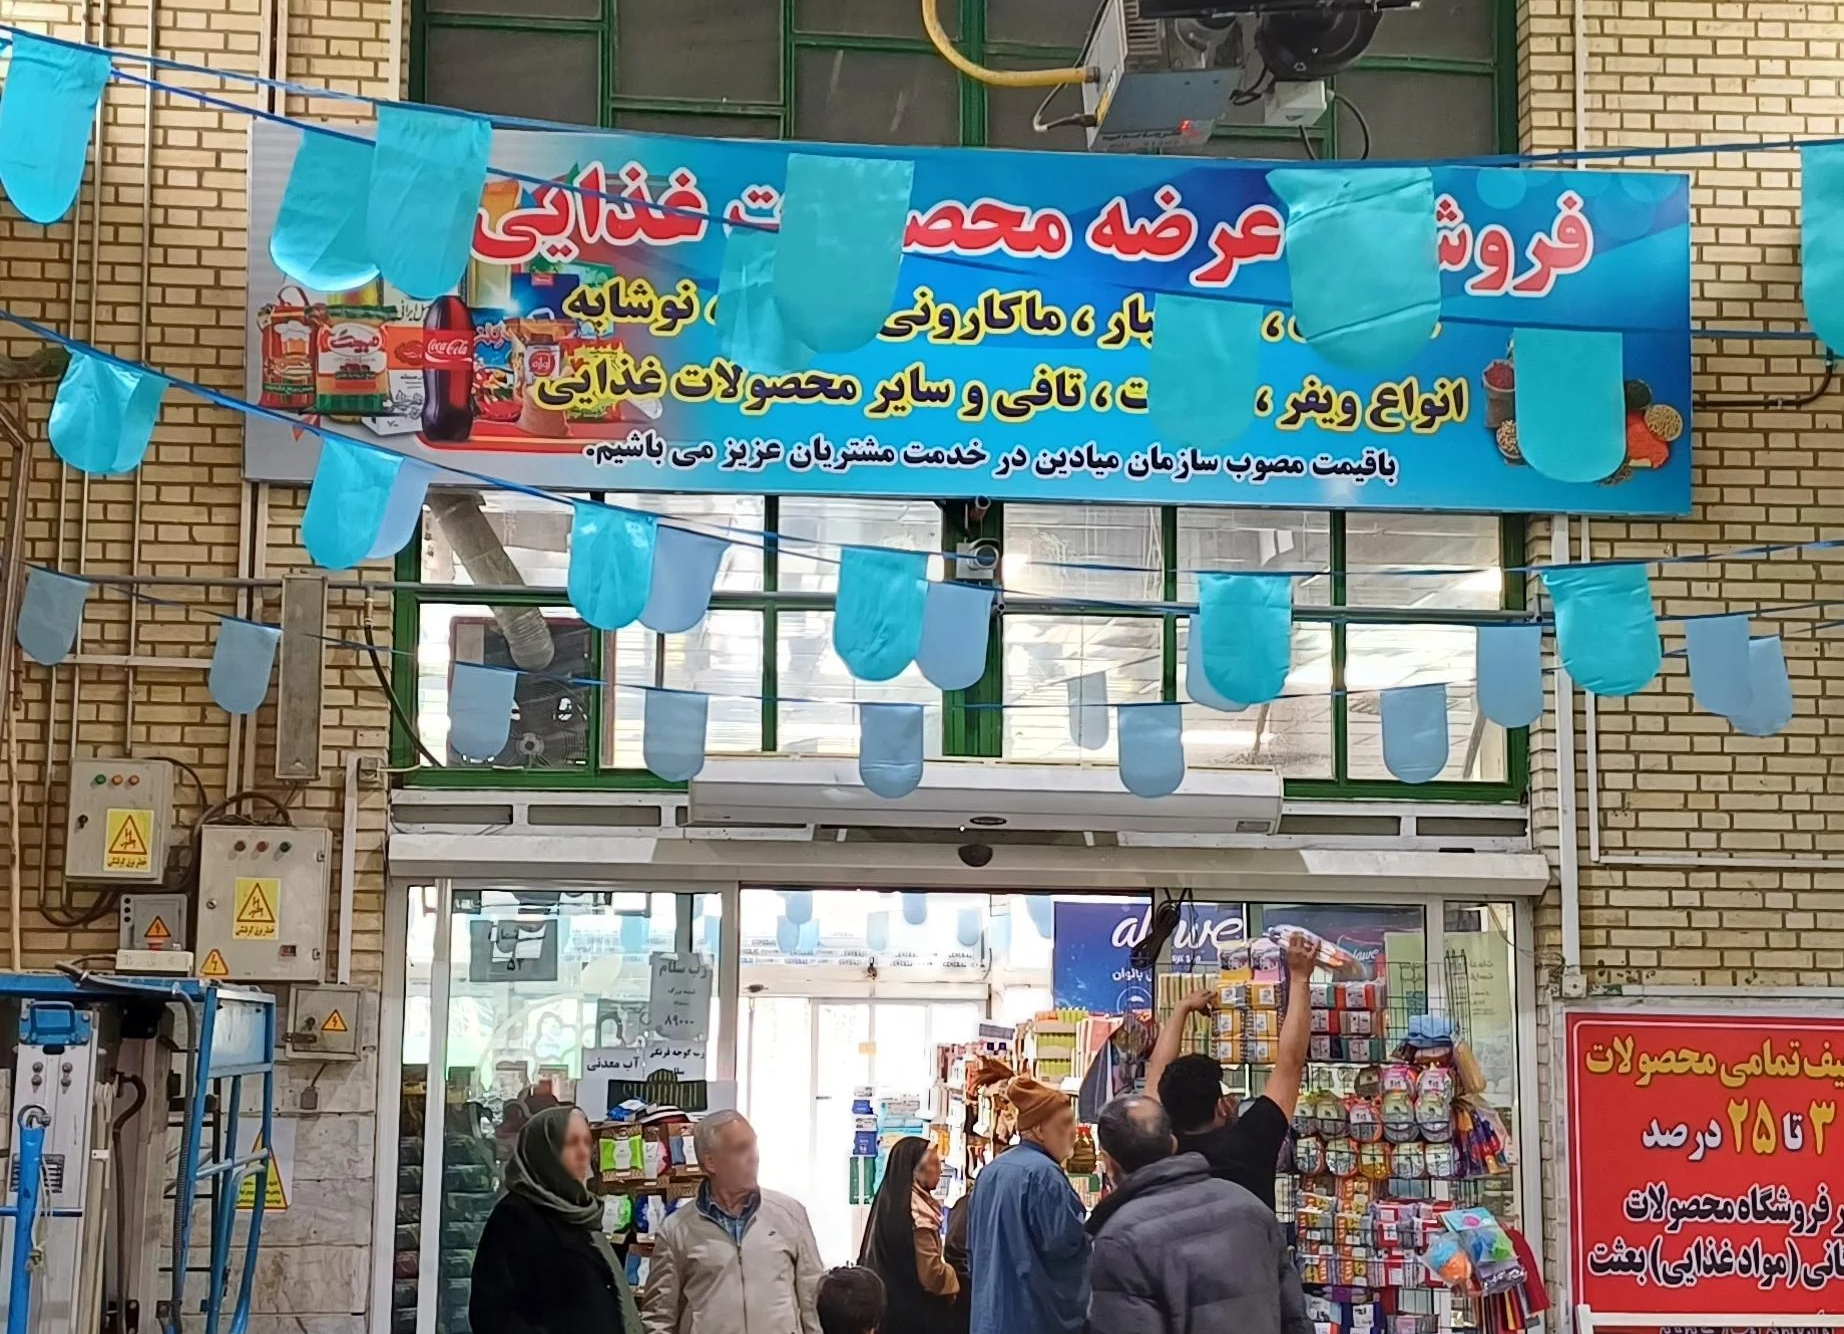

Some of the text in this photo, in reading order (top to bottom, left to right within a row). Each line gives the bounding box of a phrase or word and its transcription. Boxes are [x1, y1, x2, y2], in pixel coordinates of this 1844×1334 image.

[468, 163, 706, 261] غذایی
[1090, 188, 1284, 283] عرضه
[567, 280, 693, 333] نوشابه
[878, 287, 1061, 340] ماکارونی
[536, 357, 662, 405] غذایی
[674, 361, 856, 411] محصولات
[867, 366, 951, 413] سایر
[962, 383, 985, 417] و
[996, 368, 1082, 418] تافی
[1280, 377, 1353, 425] ویفر
[1370, 379, 1466, 429] انواع
[585, 432, 664, 465] باشیم.
[671, 442, 714, 467] می
[719, 439, 782, 470] عزیز
[788, 436, 896, 470] مشتریان
[903, 441, 988, 466] خدمت
[995, 447, 1027, 476] در
[1035, 444, 1120, 476] میادین
[1127, 445, 1218, 479] سازمان
[1225, 453, 1305, 482] مصوب
[586, 1056, 640, 1071] آب معدنی
[1585, 1034, 1717, 1086] محصولات
[1720, 1037, 1801, 1088] تمامی
[1642, 1117, 1723, 1161] درصد
[1727, 1097, 1777, 1155] ۲۵
[1782, 1111, 1803, 1151] تا
[1623, 1180, 1736, 1234] محصولات
[1738, 1182, 1830, 1236] فروشگاه
[1588, 1238, 1648, 1285] بعثت
